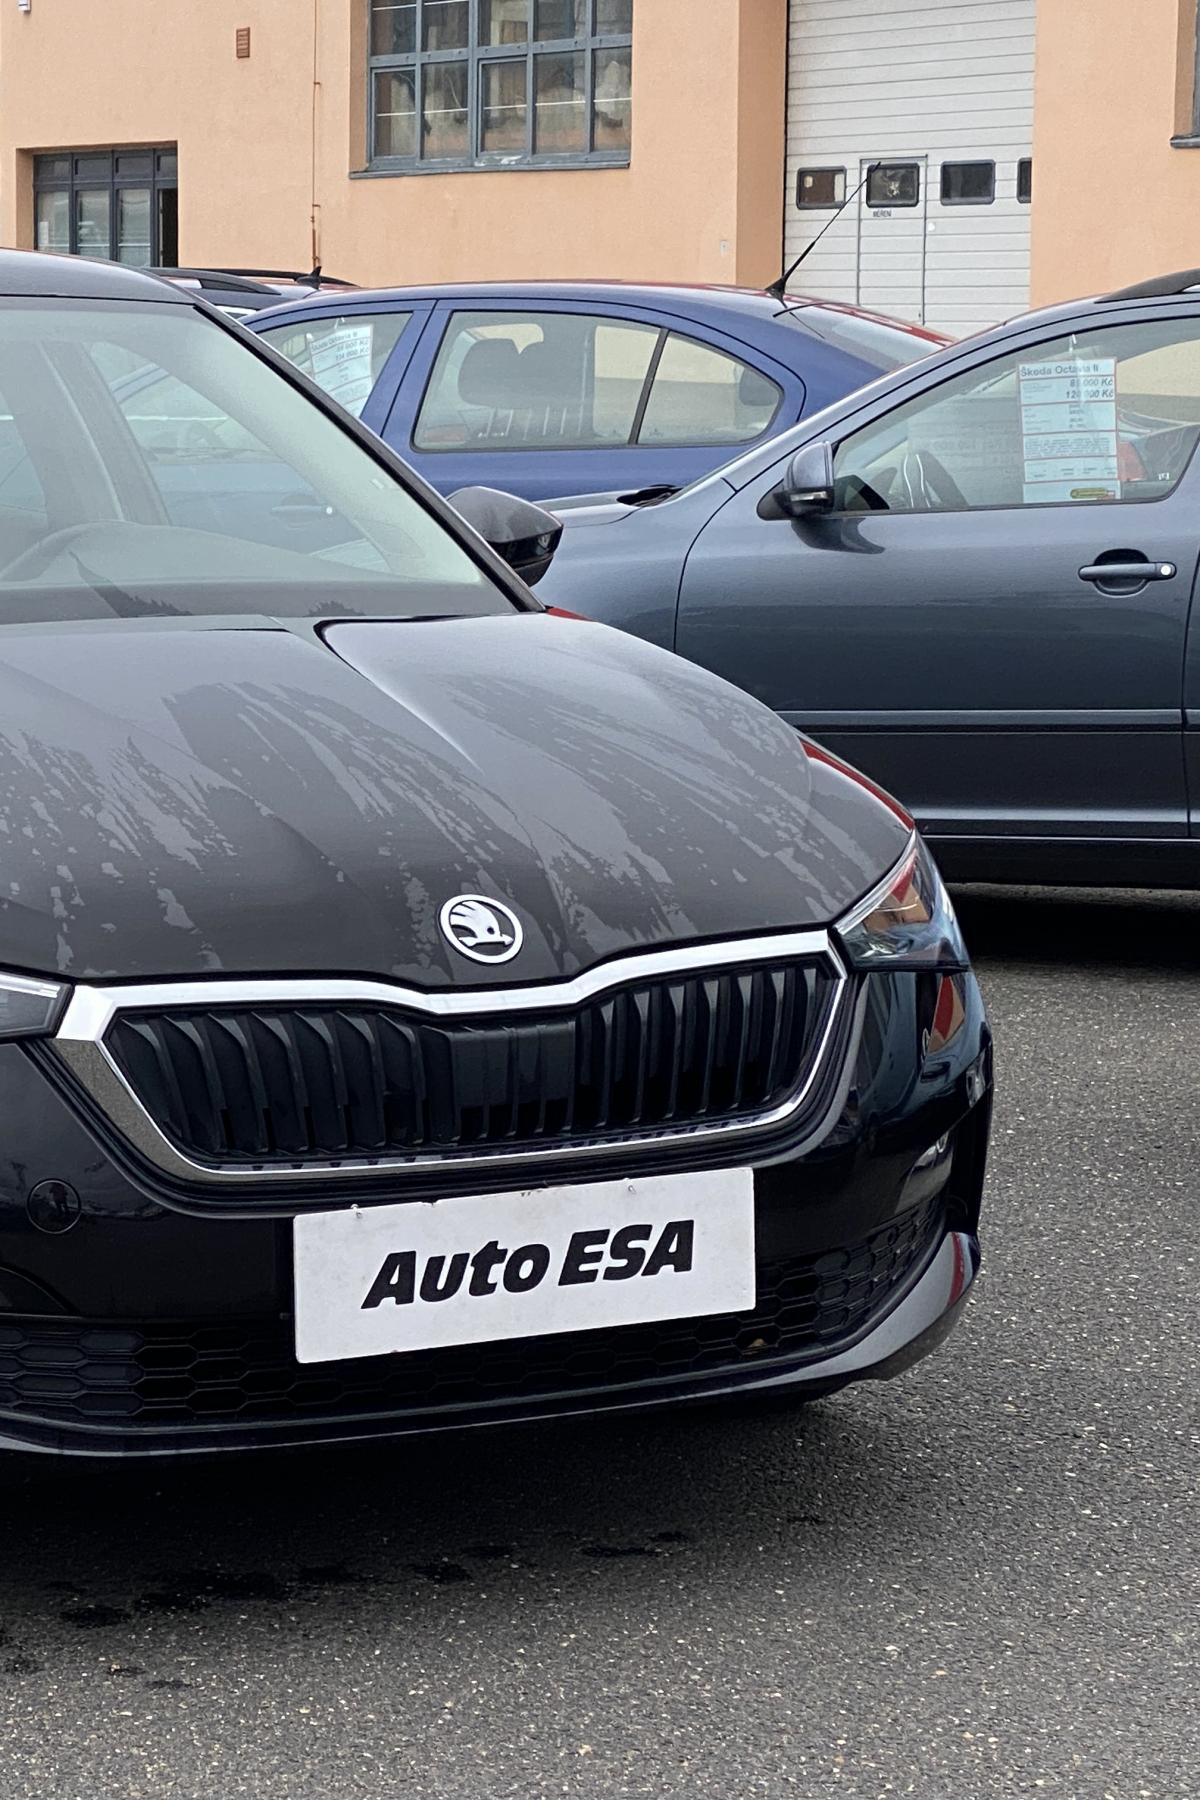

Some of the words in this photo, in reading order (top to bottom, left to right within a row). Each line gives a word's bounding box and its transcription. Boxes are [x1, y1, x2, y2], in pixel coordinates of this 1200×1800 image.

[1021, 366, 1052, 376] Škoda
[1055, 364, 1090, 374] Octaia
[1101, 378, 1113, 386] Kč
[1102, 389, 1114, 397] Kč
[360, 1240, 550, 1309] Auto
[558, 1219, 694, 1287] ESA
